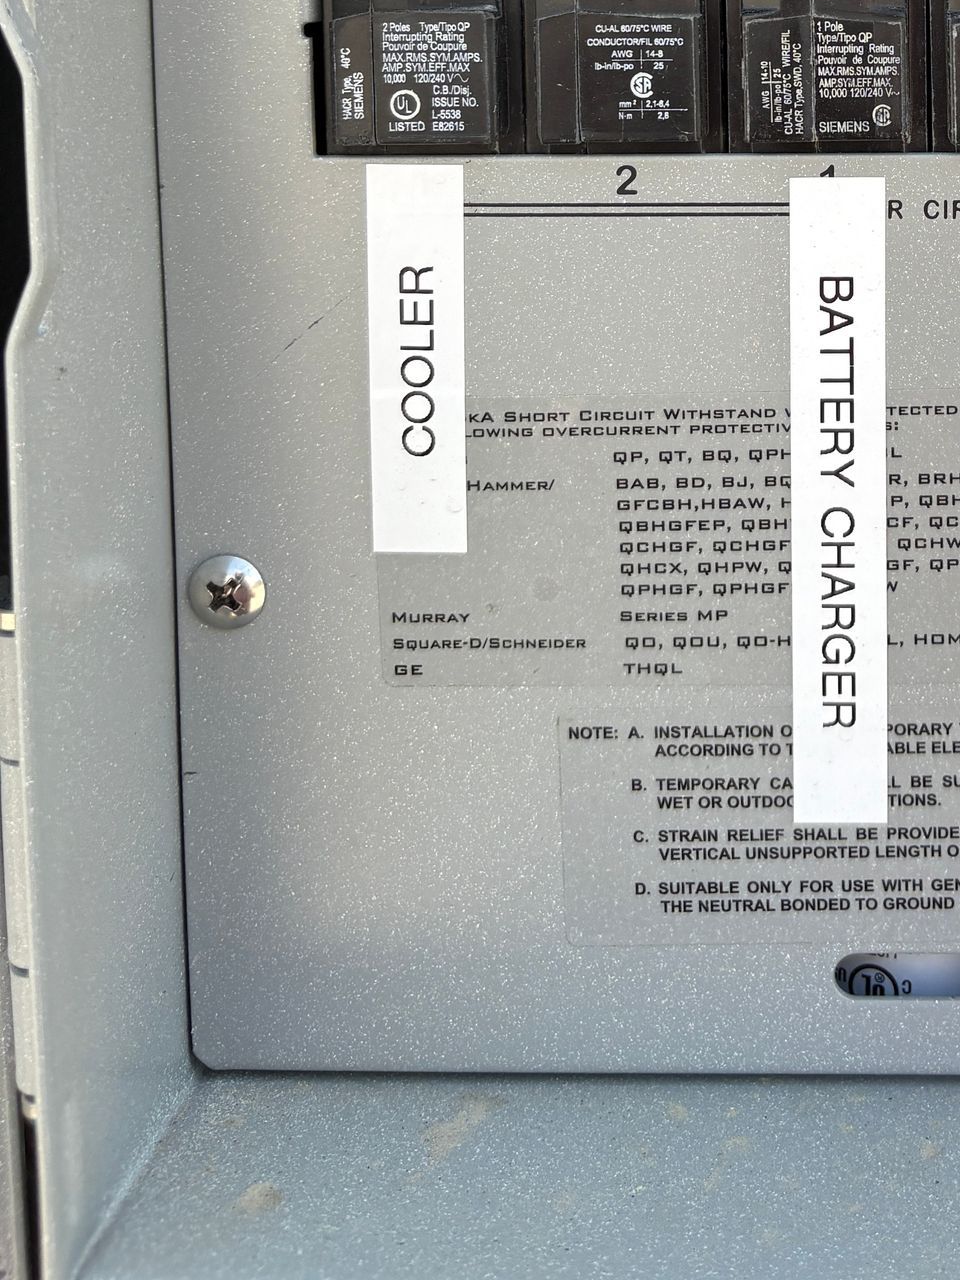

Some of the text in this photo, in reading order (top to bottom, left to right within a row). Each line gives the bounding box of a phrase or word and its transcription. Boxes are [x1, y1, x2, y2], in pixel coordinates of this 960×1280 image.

[419, 23, 470, 33] Type/Tipo QP
[825, 21, 843, 31] Pole
[383, 33, 464, 42] Interrupting Rating
[587, 38, 652, 46] CONDUCTOR/FIL
[352, 72, 364, 119] SIEMENS
[819, 88, 883, 97] 10,000 120/240
[432, 110, 461, 119] L-5538
[389, 121, 464, 131] LISTED E82615
[819, 121, 869, 132] SIEMENS
[616, 165, 637, 195] 2
[399, 267, 435, 456] COOLER
[543, 426, 680, 436] OVERCURRENT
[614, 450, 738, 464] QP, QT, BQ,
[617, 479, 665, 490] BAB,
[820, 277, 856, 727] BATTERY CHARGER
[620, 520, 730, 534] QBHGFEP,
[620, 542, 702, 555] QCHGF,
[621, 563, 687, 576] QHCX,
[622, 584, 702, 597] QPHGF,
[698, 610, 727, 621] MP
[395, 665, 422, 675] GE
[624, 663, 682, 676] THQL
[569, 727, 617, 739] NOTE:
[628, 727, 643, 739] A.
[655, 725, 773, 738] INSTALLATION
[655, 744, 753, 756] ACCORDING
[759, 744, 781, 755] TO
[632, 779, 646, 791] B.
[656, 778, 760, 790] TEMPORARY
[911, 776, 932, 787] BE
[657, 797, 722, 809] WET OR
[634, 831, 648, 842] C.
[659, 830, 717, 842] STRAIN
[728, 829, 784, 841] RELIEF
[794, 829, 847, 840] SHALL
[857, 828, 877, 840] BE
[659, 848, 740, 860] VERTICAL
[746, 846, 869, 859] UNSUPPORTED
[876, 845, 941, 858] LENGTH
[636, 883, 650, 895] D.
[659, 882, 739, 894] SUITABLE
[748, 881, 791, 893] ONLY
[800, 881, 833, 892] FOR
[842, 880, 874, 892] USE
[882, 879, 922, 891] WITH
[661, 901, 692, 912] THE
[699, 900, 775, 912] NEUTRAL
[781, 899, 850, 911] BONDED
[855, 898, 877, 910] TO
[883, 897, 954, 910] GROUND
